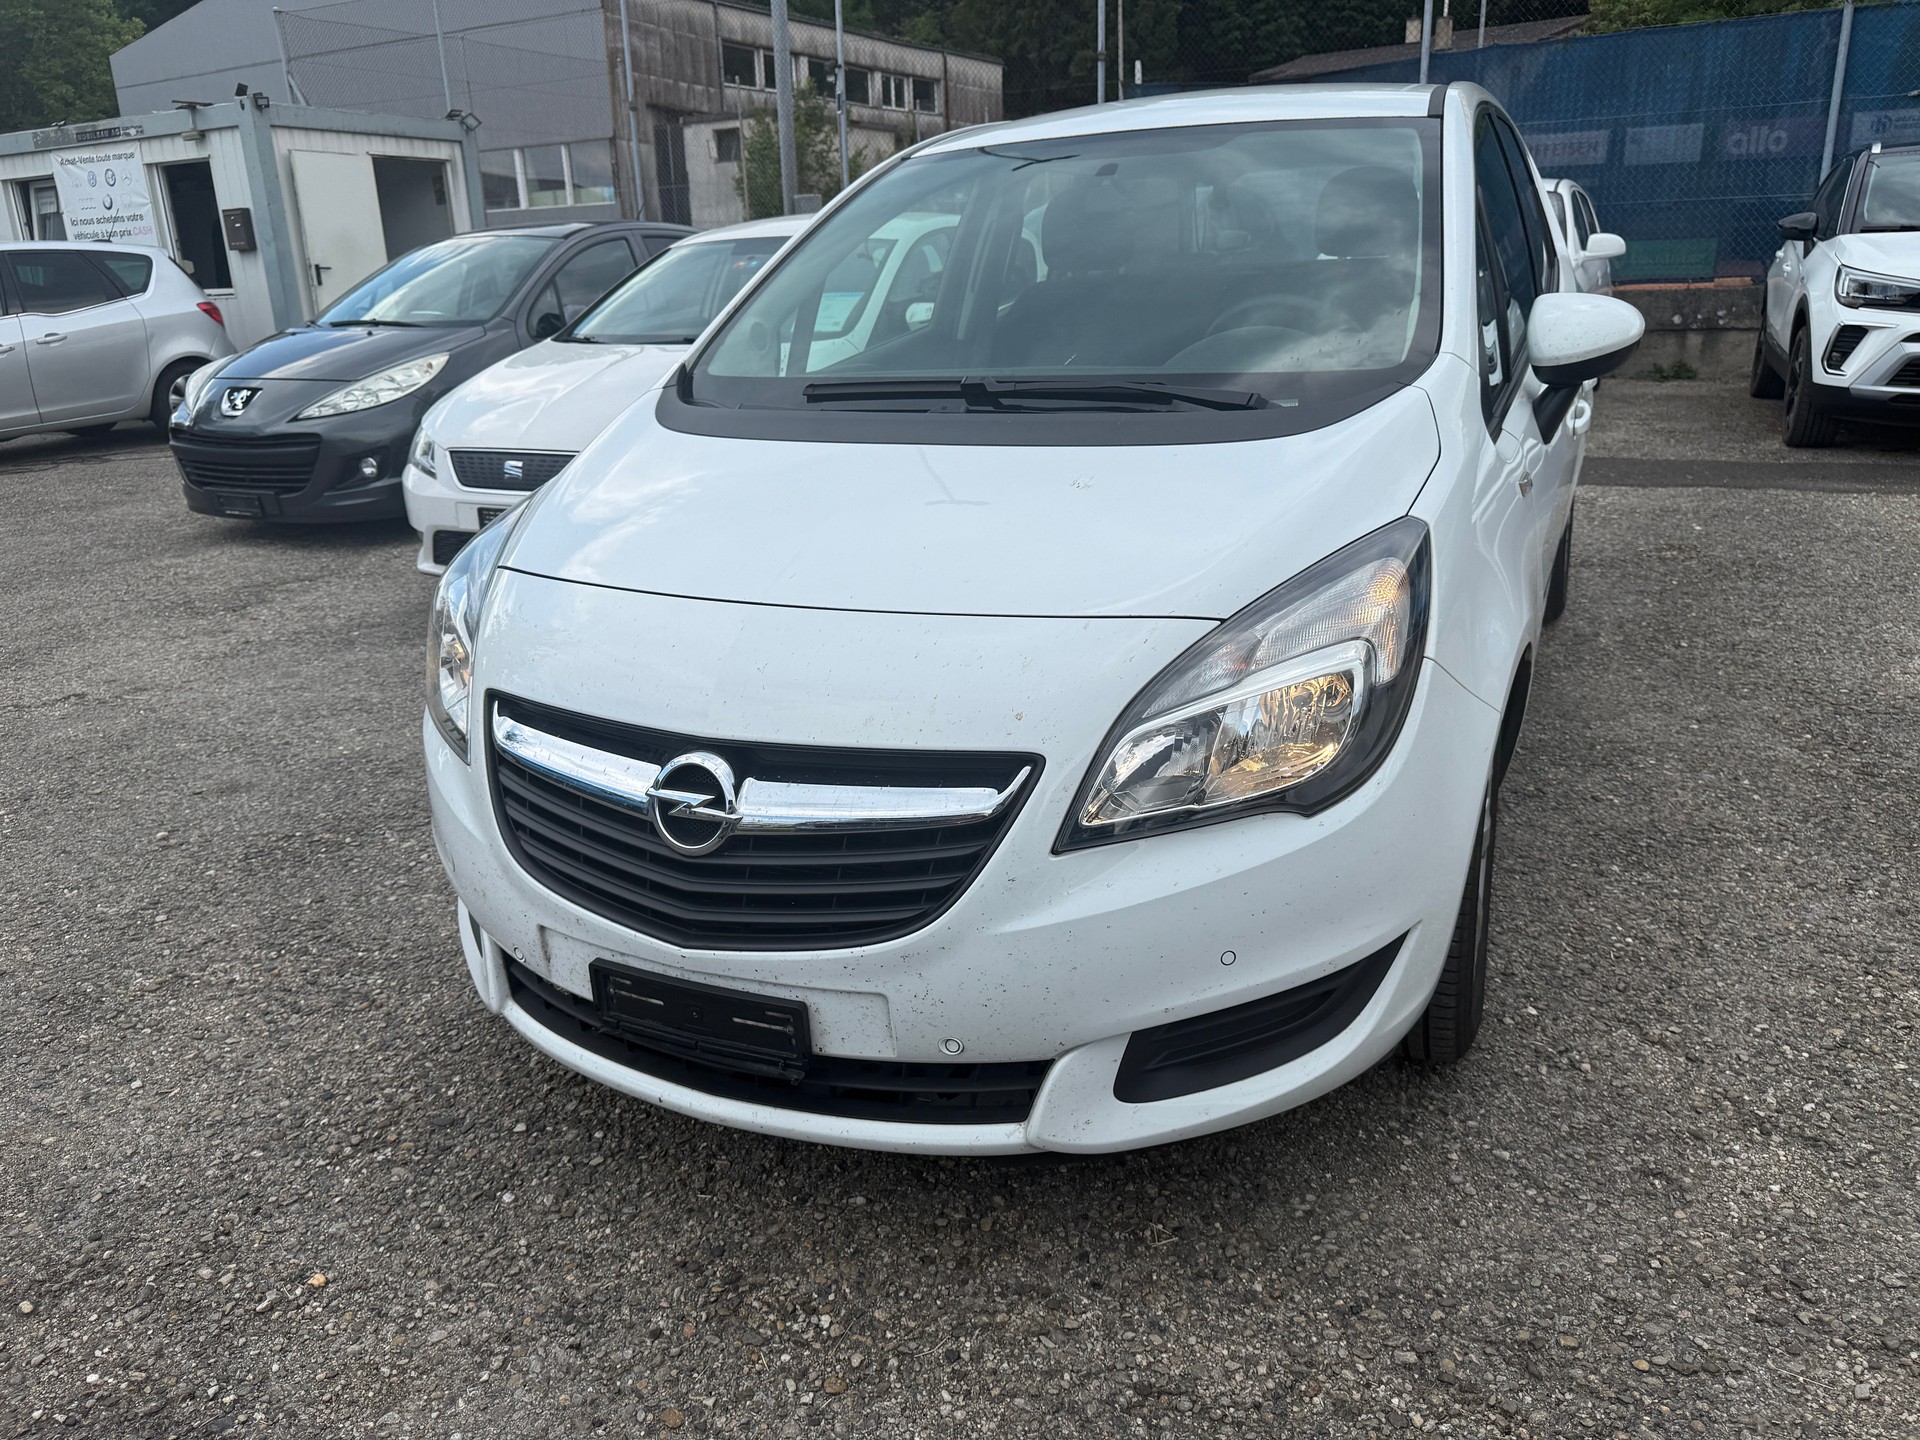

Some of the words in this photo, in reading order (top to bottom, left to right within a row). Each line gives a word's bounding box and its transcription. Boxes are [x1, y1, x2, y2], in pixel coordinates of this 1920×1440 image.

[112, 151, 135, 161] marque
[70, 217, 79, 226] Ici
[80, 216, 95, 225] nous
[126, 212, 144, 222] votre
[120, 227, 132, 239] prix
[133, 225, 153, 236] CASH
